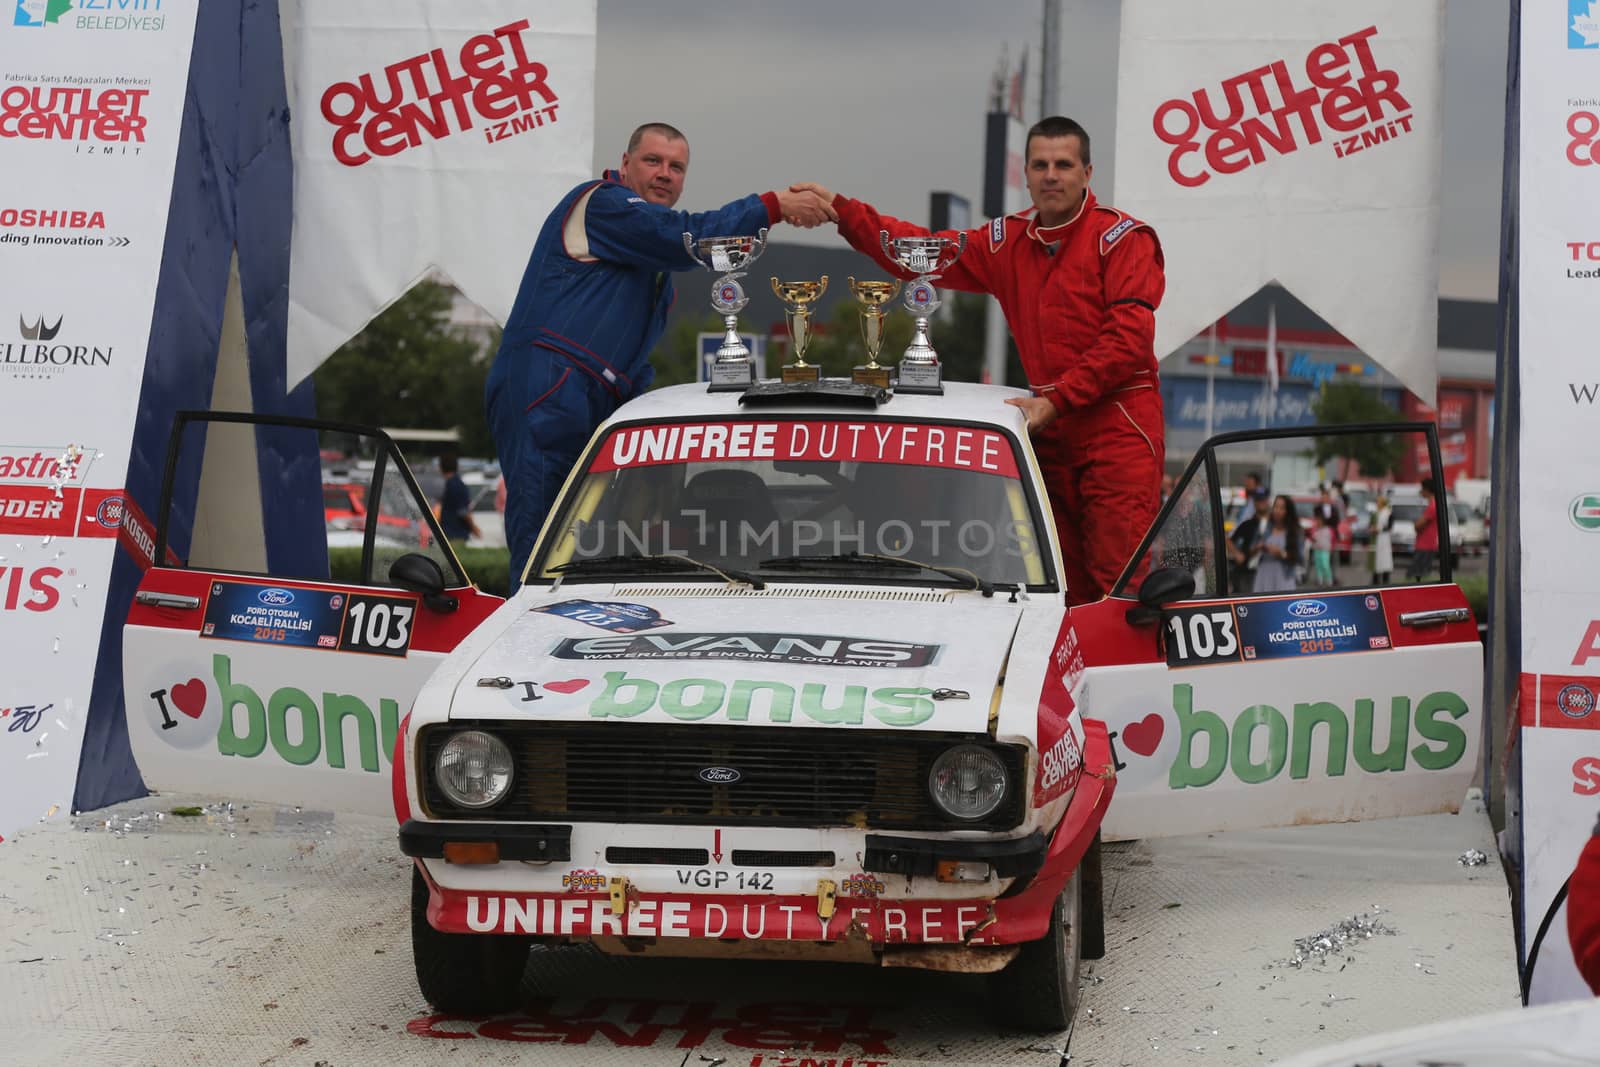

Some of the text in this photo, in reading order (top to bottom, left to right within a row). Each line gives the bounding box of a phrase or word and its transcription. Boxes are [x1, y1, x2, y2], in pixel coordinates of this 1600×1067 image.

[76, 14, 166, 31] BELEDİYESİ
[5, 74, 38, 82] Fabrika
[115, 77, 151, 85] Merkezi
[0, 208, 105, 229] OSHIBA
[33, 234, 104, 246] Innovation
[613, 424, 778, 465] UNIFREE
[247, 607, 299, 618] FORD OTOSAN
[563, 609, 624, 626] 103
[231, 613, 312, 631] KOCAELİ RALLİSİ
[350, 602, 413, 649] 103
[1283, 618, 1339, 630] FORD OTOSAN
[254, 627, 286, 640] 2015
[1169, 612, 1237, 659] 103
[1269, 624, 1357, 642] KOCAELİ RALLİSİ
[573, 634, 915, 662] EVANS
[1301, 640, 1335, 653] 2015
[583, 651, 899, 668] WATERLESS ENGINE COOLANTS
[590, 671, 935, 727] bonus
[1168, 683, 1469, 790] bonus
[705, 768, 734, 782] Ford
[562, 875, 606, 888] POWER
[677, 870, 775, 891] VGP 142
[842, 878, 885, 894] POWER
[466, 896, 691, 937] UNIFREE
